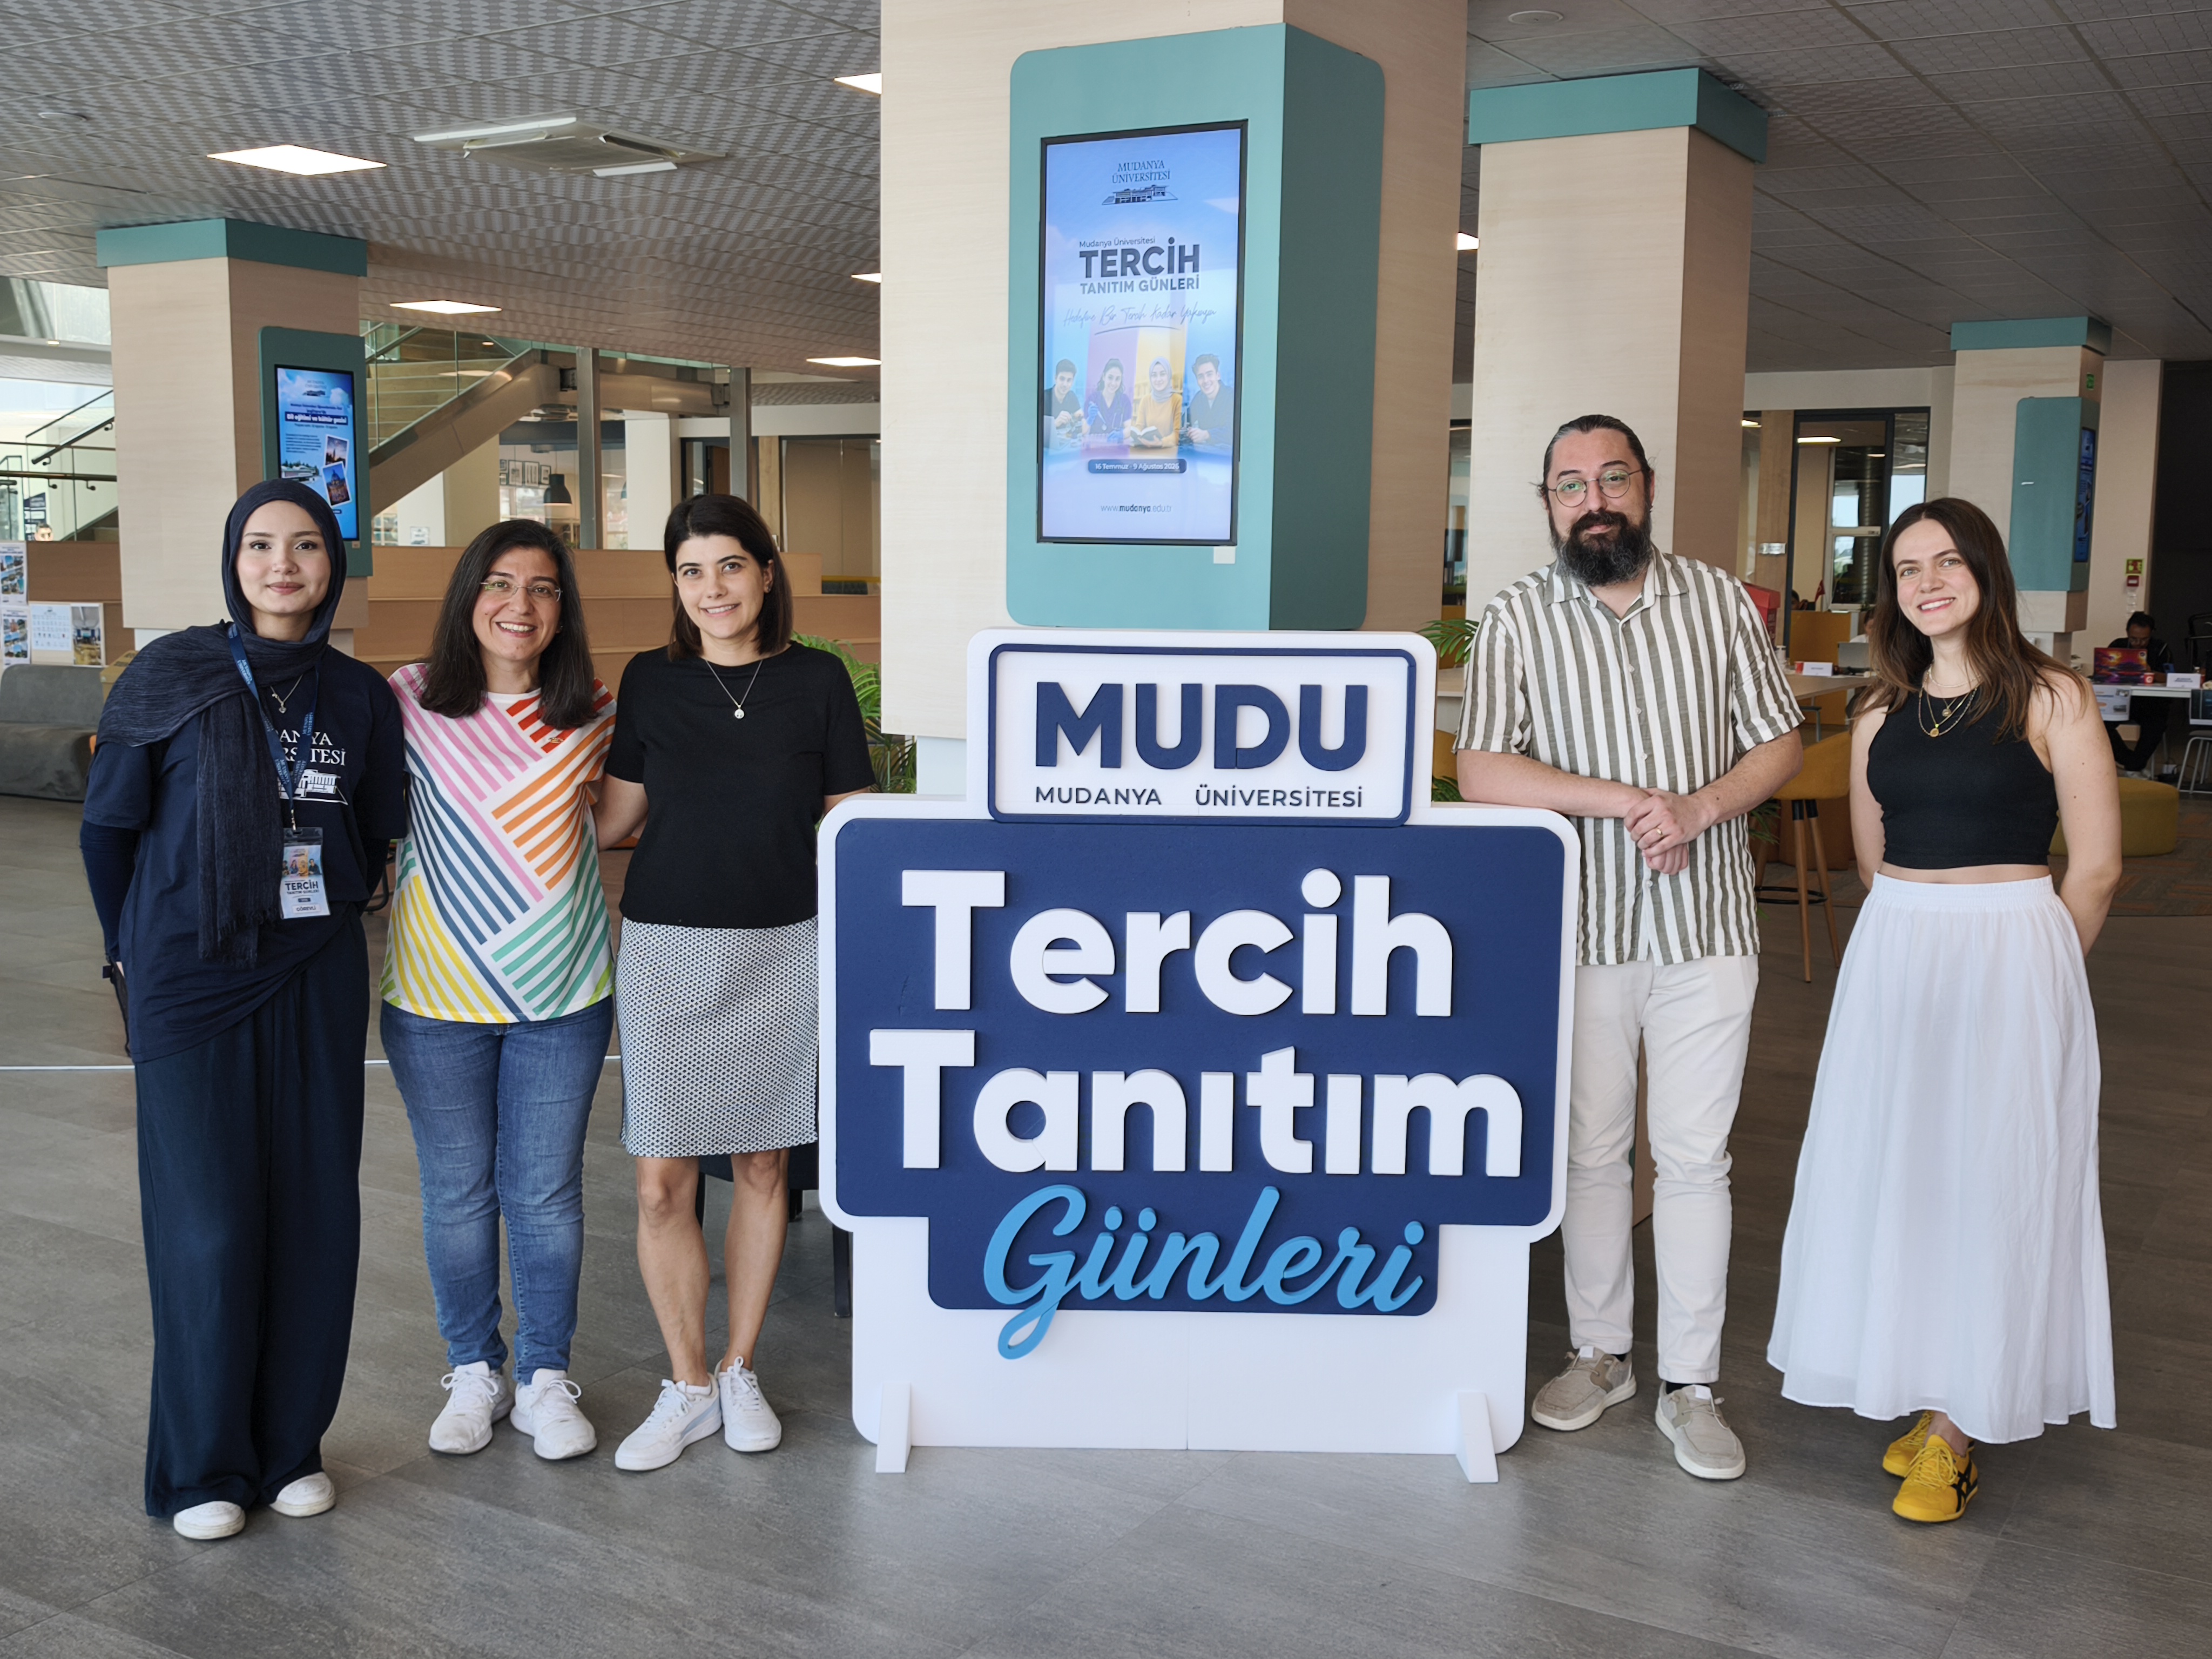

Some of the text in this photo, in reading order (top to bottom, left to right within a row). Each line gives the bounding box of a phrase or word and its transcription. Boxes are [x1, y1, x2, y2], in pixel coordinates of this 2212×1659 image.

[1118, 160, 1165, 172] MUDANYA
[1112, 169, 1170, 184] ÜNİVERSİTESİ
[1080, 236, 1155, 248] Mudanya Üniversitesi
[1079, 237, 1200, 278] TERCİH
[1080, 274, 1199, 295] TANITIM GÜNLERİ
[1150, 304, 1177, 322] Kadar
[1138, 462, 1163, 471] Ağustos
[1101, 504, 1172, 514] www.mudanya.edu.tr
[1036, 682, 1368, 771] MUDU
[1035, 784, 1363, 808] MUDANYA ÜNİVERSİTESİ
[285, 879, 319, 891] TERCİH
[901, 867, 1453, 1017] Tercih
[869, 1029, 1523, 1177] Tanıtım
[982, 1184, 1425, 1360] Günleri
